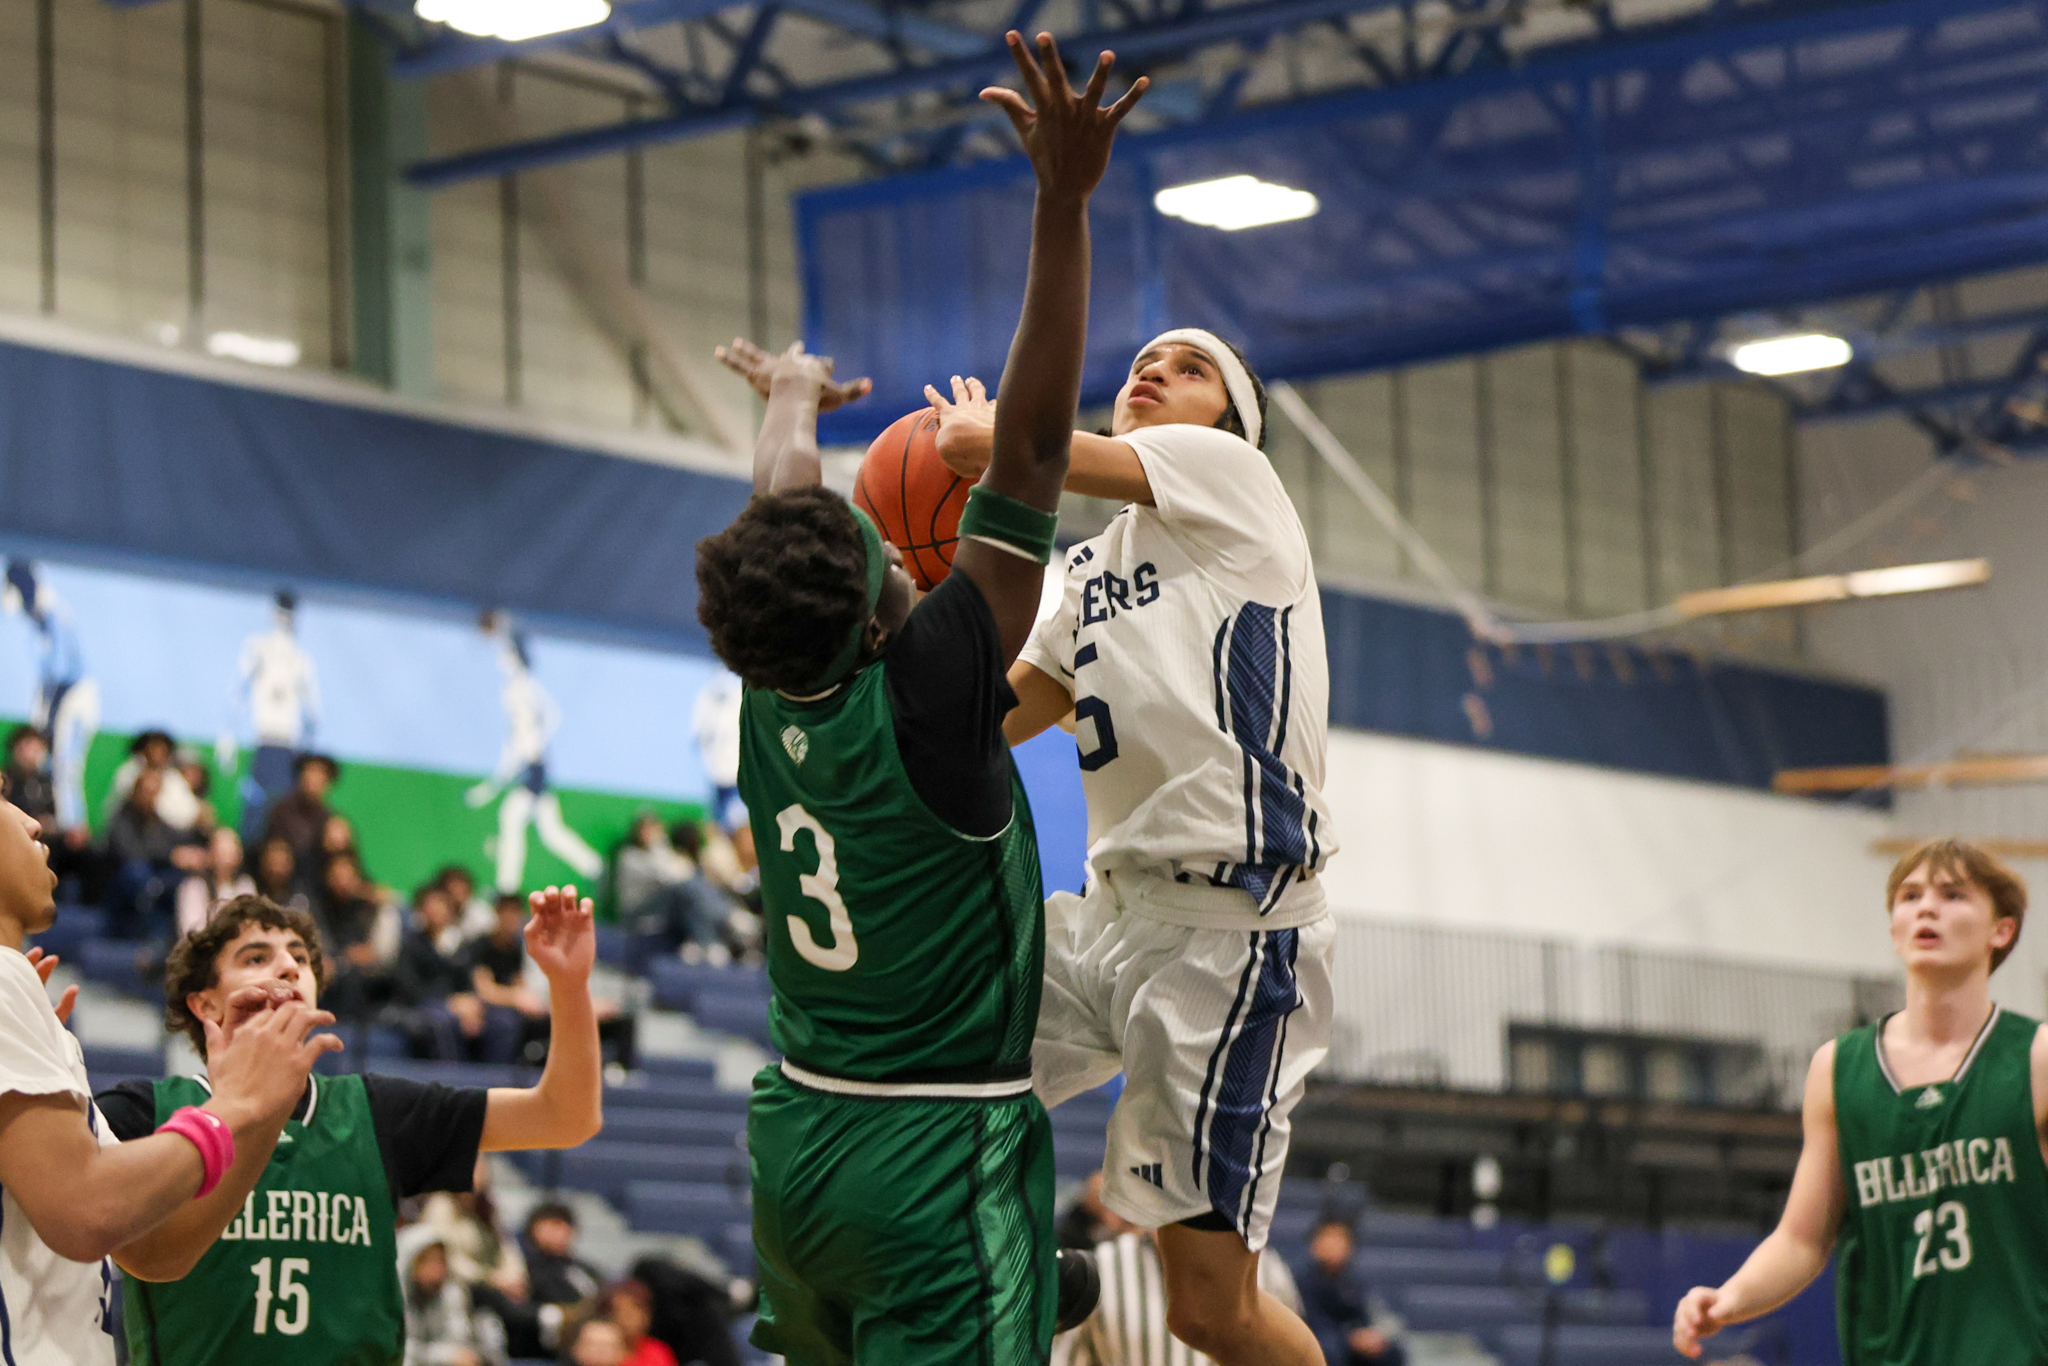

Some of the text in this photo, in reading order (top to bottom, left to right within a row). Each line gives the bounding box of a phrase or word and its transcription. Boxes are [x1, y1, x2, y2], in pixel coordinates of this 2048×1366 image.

[1074, 561, 1160, 644] ERS
[775, 803, 859, 972] 3
[1912, 1200, 1972, 1279] 23
[250, 1257, 310, 1335] 15
